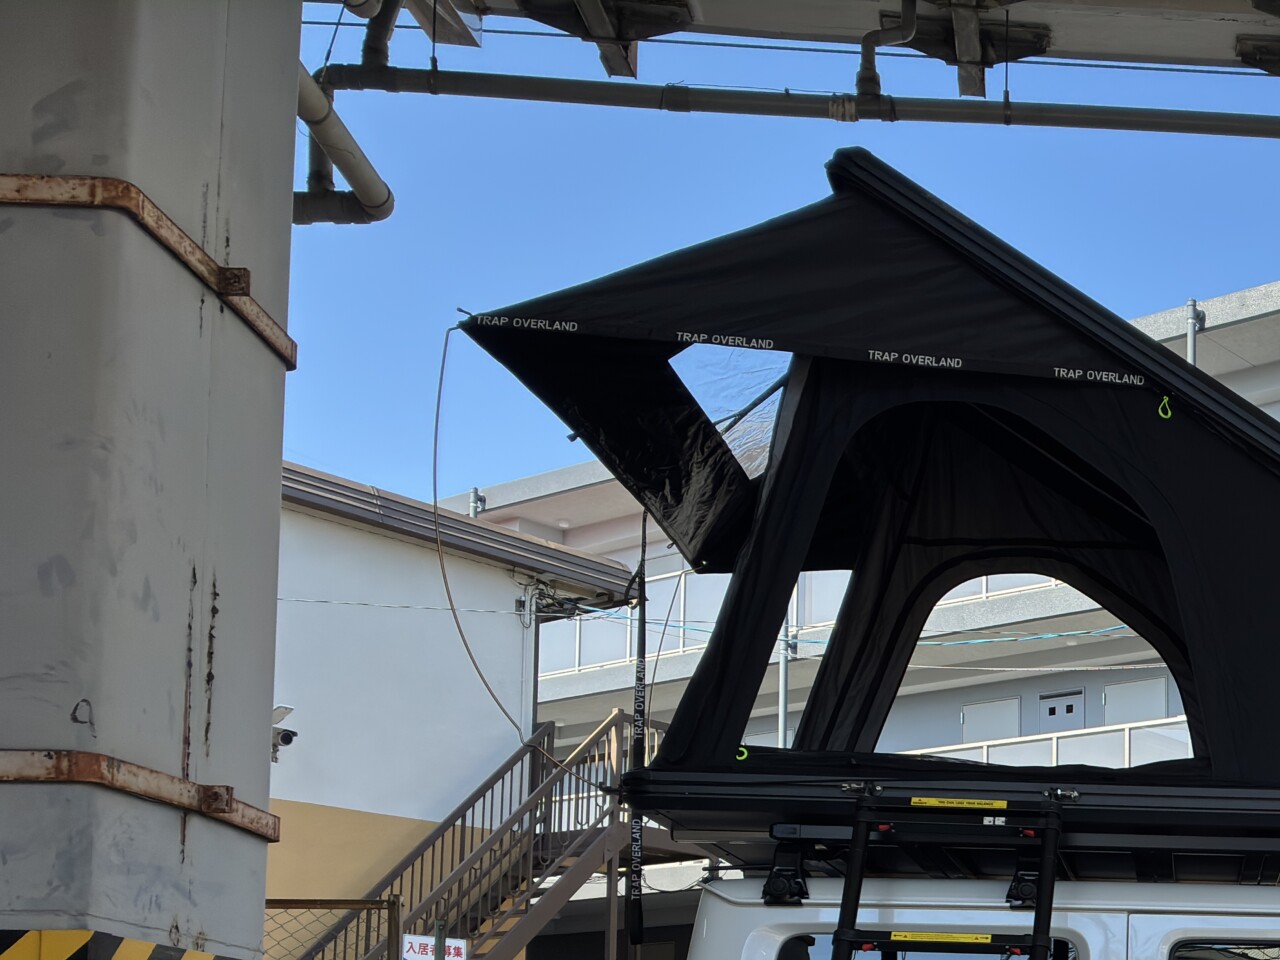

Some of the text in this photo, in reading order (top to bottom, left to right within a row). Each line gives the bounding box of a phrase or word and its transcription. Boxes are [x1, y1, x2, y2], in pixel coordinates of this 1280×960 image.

[476, 315, 578, 332] TRAP OVERLAND
[676, 331, 774, 349] TRAP OVERLAND
[868, 349, 962, 368] TRAP OVERLAND
[1053, 367, 1145, 386] TRAP OVERLAND
[634, 658, 646, 740] TRAP OVERLAND
[631, 818, 642, 901] TRAP OVERLAND
